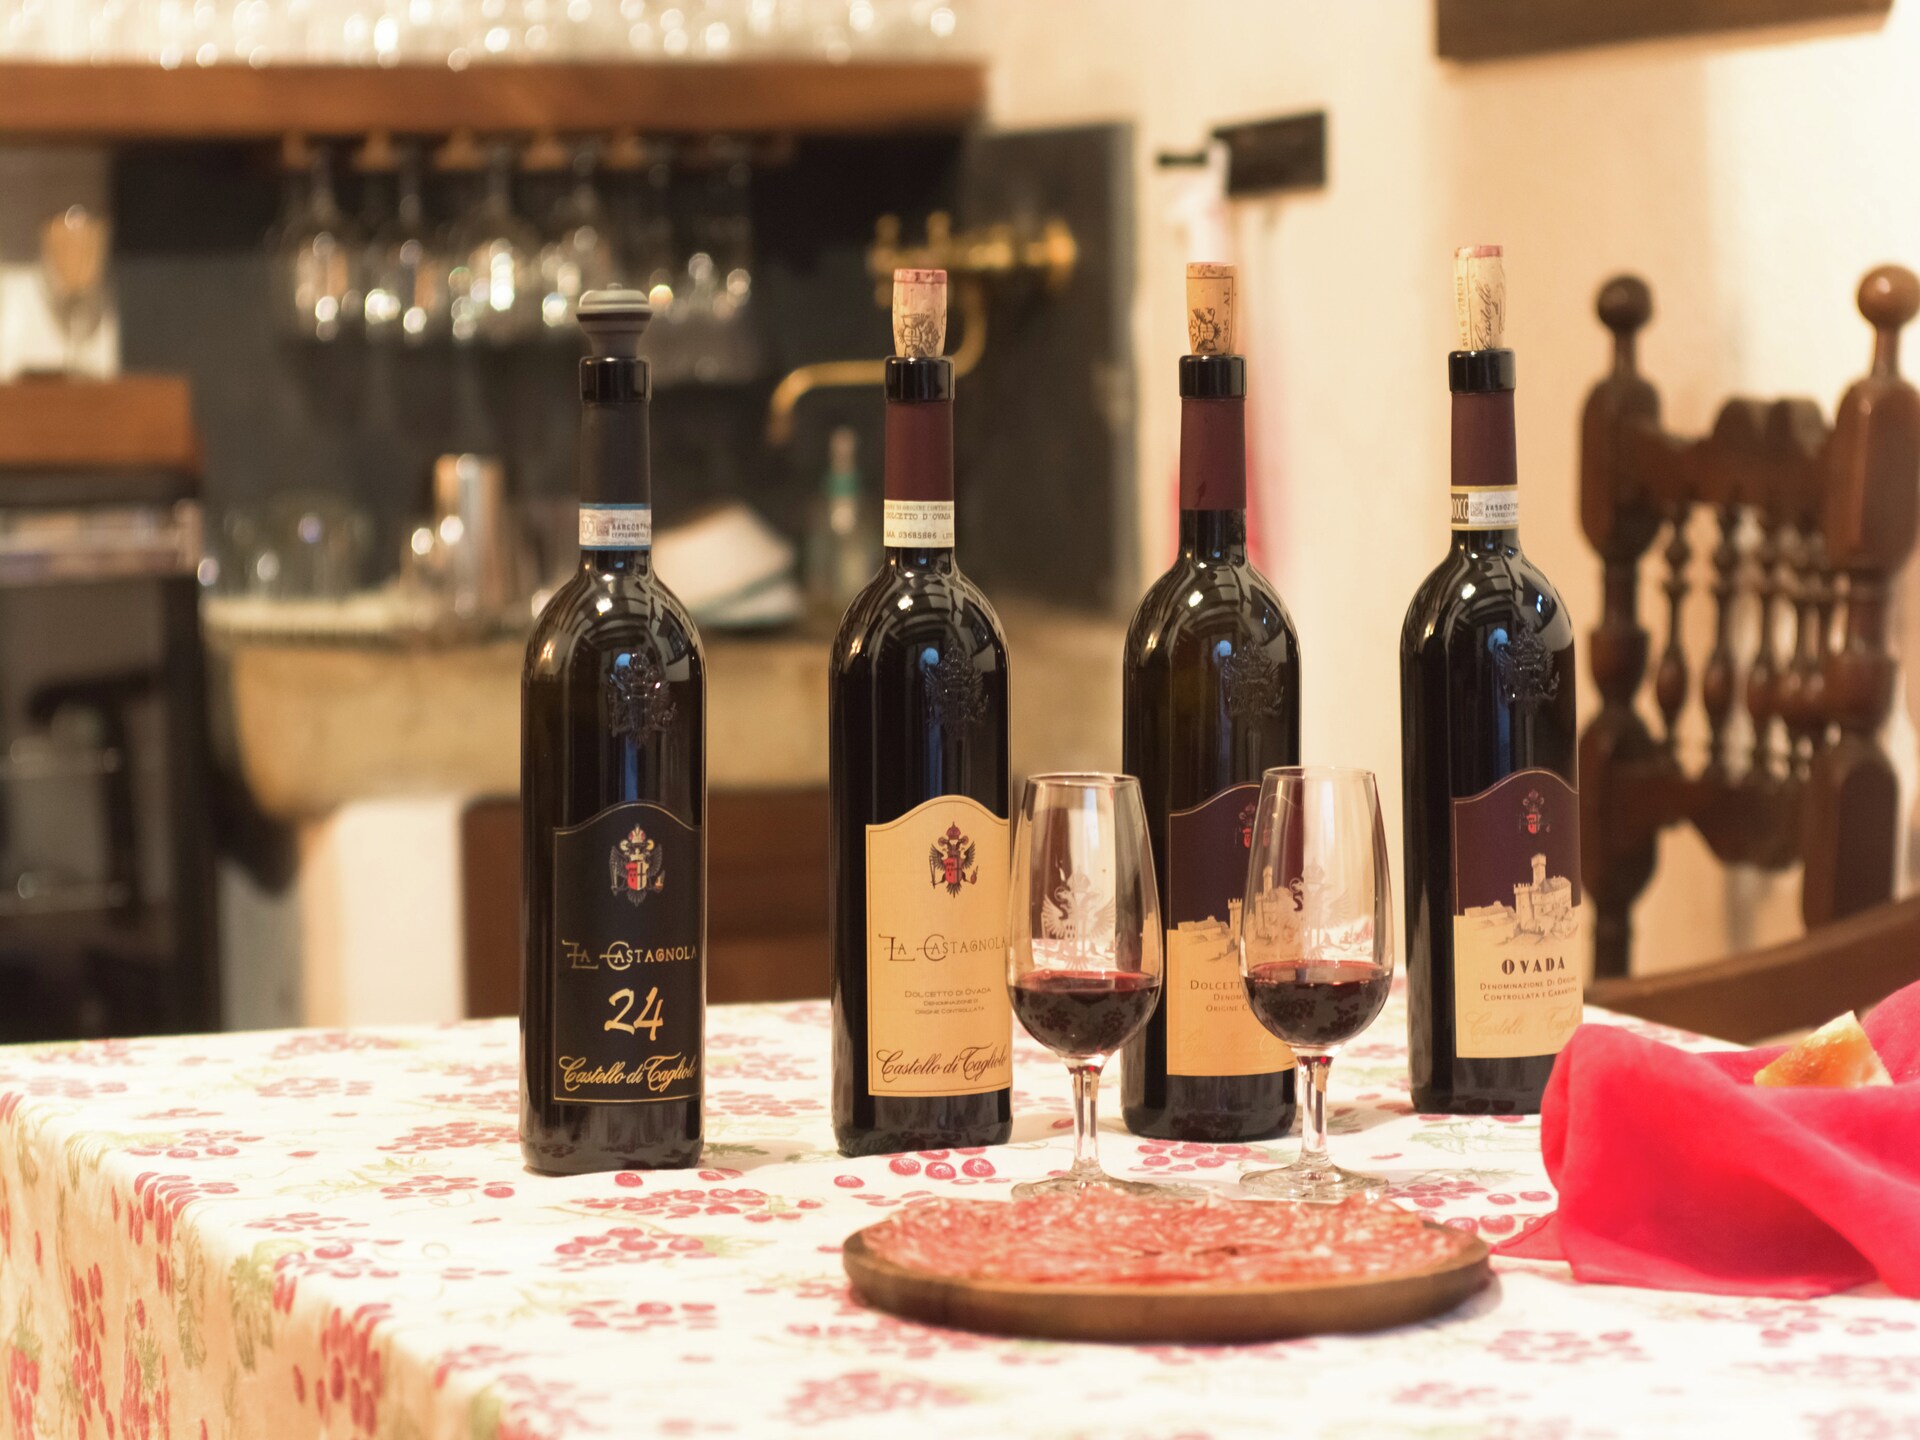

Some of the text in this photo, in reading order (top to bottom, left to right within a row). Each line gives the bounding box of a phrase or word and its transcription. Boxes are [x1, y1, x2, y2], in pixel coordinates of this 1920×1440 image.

[562, 939, 697, 971] LA CASTAGNOLA
[878, 933, 1005, 962] LA CASTAGNOLA
[1501, 956, 1566, 976] OVADA
[904, 990, 954, 998] DOLCETTO
[965, 987, 992, 996] OVADA
[1190, 980, 1241, 990] DOLCETT
[1480, 981, 1544, 991] DENOMINAZIONE
[1546, 979, 1556, 987] DI
[1483, 992, 1541, 1002] CONTROLLATA
[604, 987, 664, 1042] 24
[1205, 1004, 1239, 1012] ORIGINE
[559, 1055, 627, 1092] Castello
[626, 1063, 646, 1085] di
[875, 1049, 942, 1084] Castello
[942, 1054, 960, 1075] di
